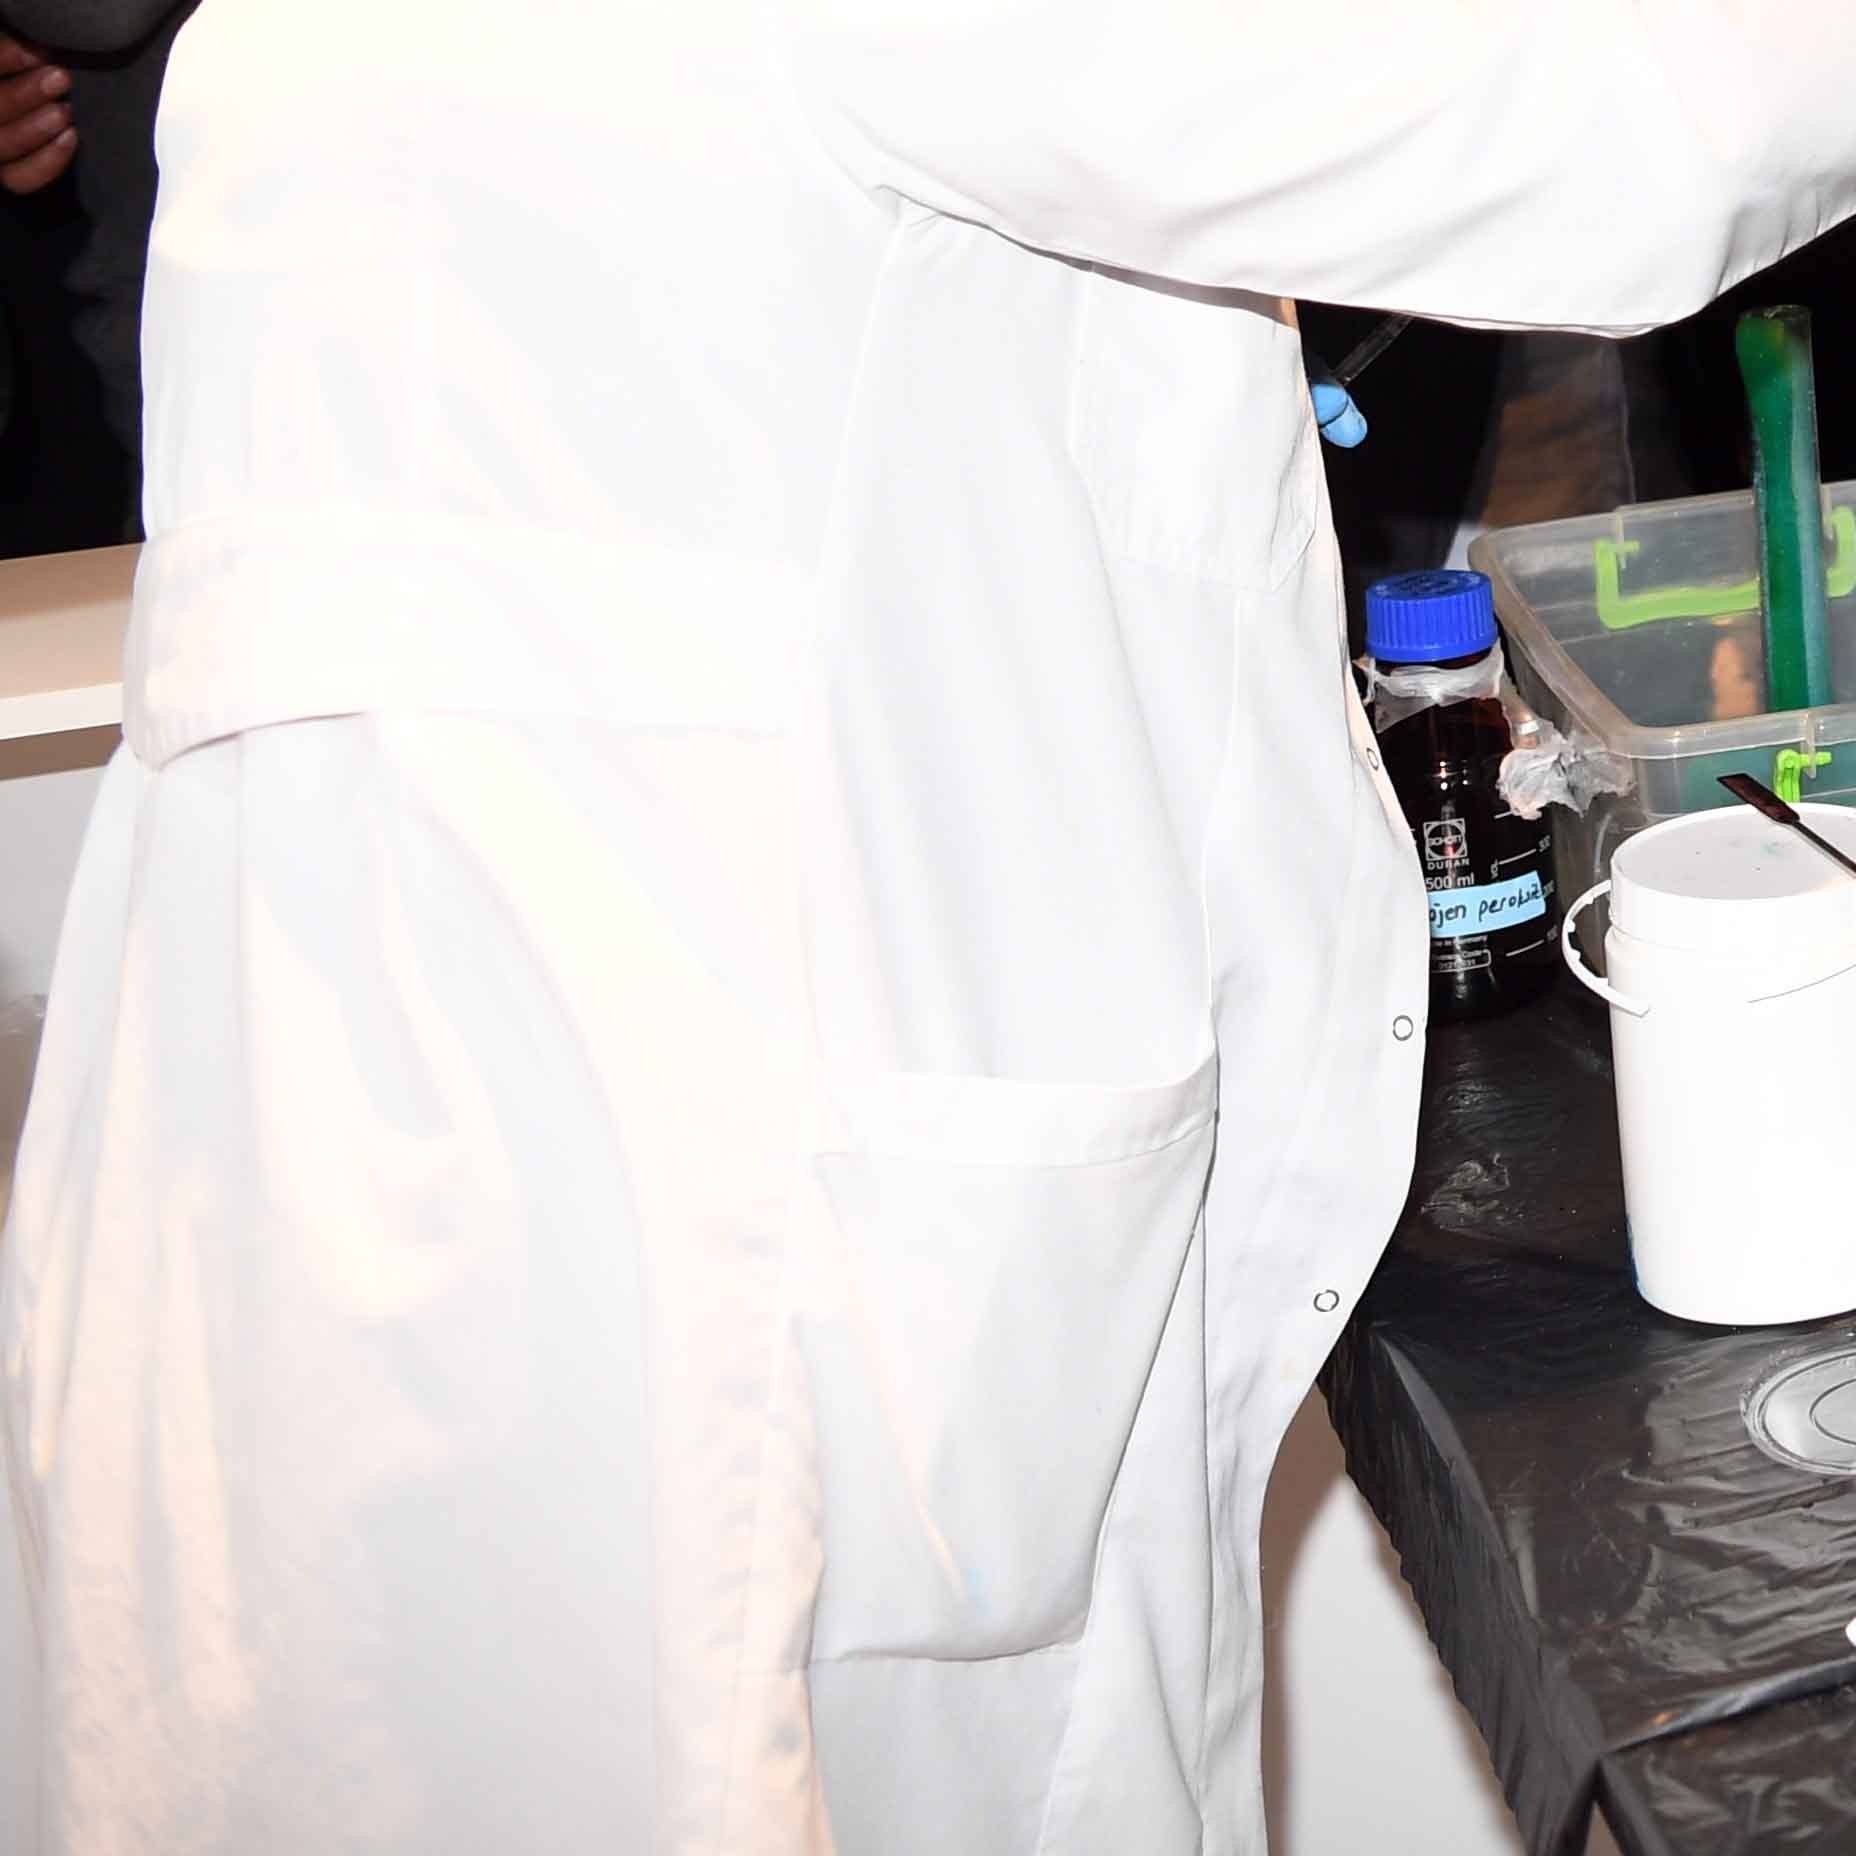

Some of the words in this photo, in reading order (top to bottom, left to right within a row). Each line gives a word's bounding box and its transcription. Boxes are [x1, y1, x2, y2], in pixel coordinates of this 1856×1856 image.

[1427, 857, 1470, 871] DURAN
[1425, 875, 1453, 890] 500
[1457, 871, 1475, 887] ml
